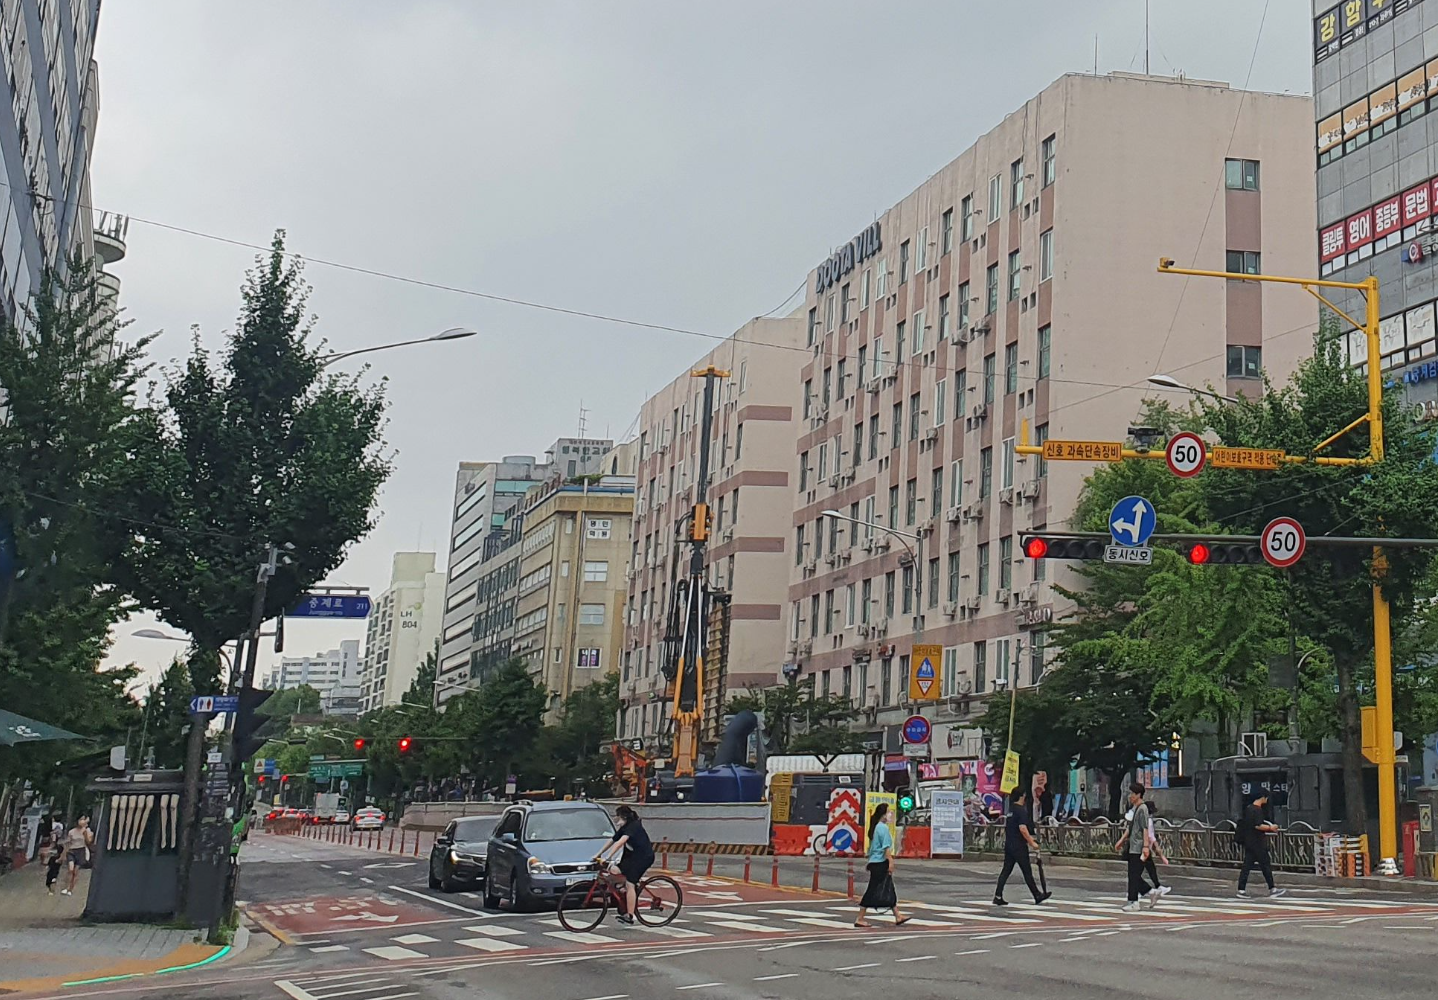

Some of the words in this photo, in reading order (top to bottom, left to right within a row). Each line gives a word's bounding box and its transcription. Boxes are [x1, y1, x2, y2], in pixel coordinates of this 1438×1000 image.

[1349, 213, 1371, 244] 영어
[1375, 200, 1399, 232] 중등부
[1405, 187, 1428, 221] 문법
[814, 242, 855, 295] DOOTA
[854, 220, 882, 264] VILL
[1046, 443, 1064, 460] 신호
[1067, 444, 1120, 460] 과속단속장비
[1174, 444, 1198, 465] 50
[1270, 531, 1296, 552] 50
[1108, 548, 1150, 563] 동시신호
[309, 597, 344, 609] 중계로
[356, 602, 368, 610] 211
